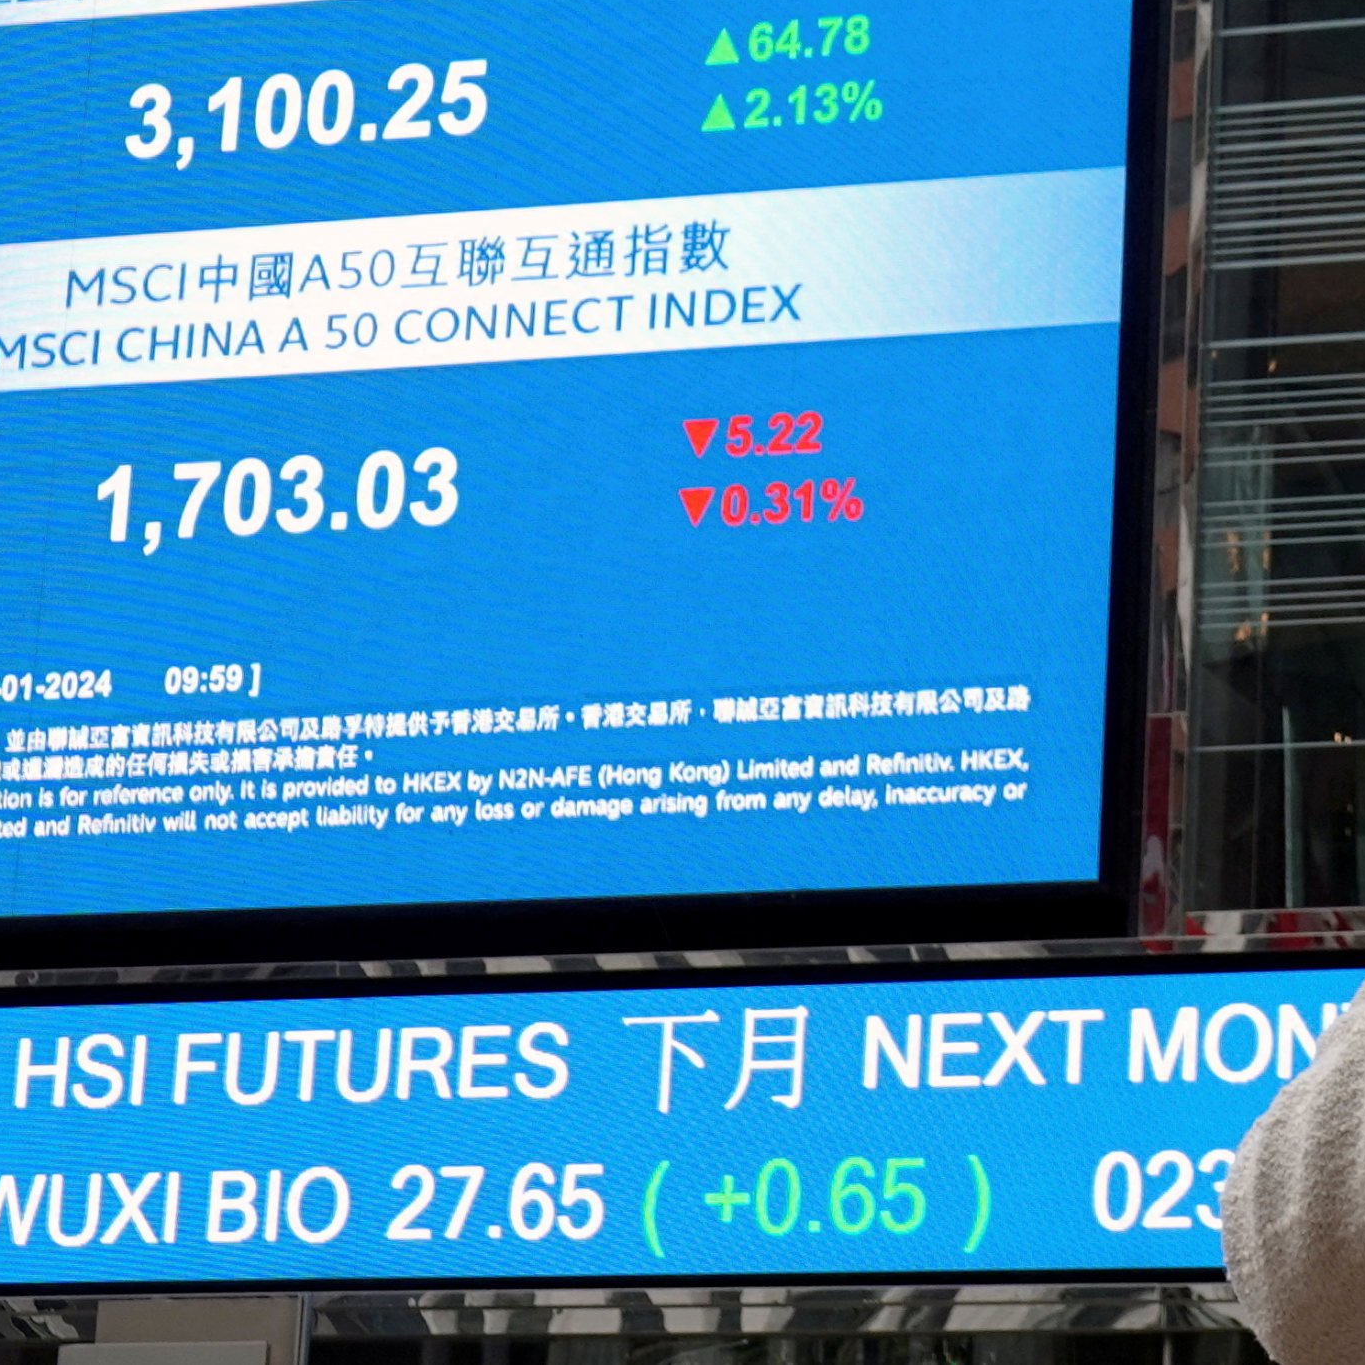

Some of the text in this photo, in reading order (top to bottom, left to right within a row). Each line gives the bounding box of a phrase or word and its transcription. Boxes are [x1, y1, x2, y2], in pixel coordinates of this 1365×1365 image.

[746, 14, 872, 63] 64.78
[124, 59, 488, 171] 3,100.25
[742, 81, 884, 129] 2.13%
[65, 218, 732, 310] MSCI中國A50互聯互通指數
[115, 319, 266, 364] CHINA
[277, 316, 310, 353] A
[324, 311, 379, 350] 50
[393, 294, 636, 346] CONNECT
[648, 282, 804, 331] INDEX
[725, 411, 825, 457] 5.22
[96, 446, 460, 557] 1,703.03
[719, 478, 864, 528] 0.31%
[33, 815, 71, 837] and
[77, 813, 157, 835] Refinitiv
[162, 810, 197, 832] will
[204, 810, 238, 831] not
[243, 808, 309, 833] accept
[315, 804, 389, 830] liability
[395, 802, 425, 824] for
[430, 804, 469, 827] any
[474, 799, 515, 821] loss
[520, 801, 545, 820] or
[550, 796, 634, 821] damage
[639, 793, 709, 818] arising
[715, 789, 767, 812] from
[772, 791, 812, 814] any
[818, 785, 879, 812] delay,
[885, 784, 997, 807] inaccuracy
[1002, 782, 1028, 801] or
[38, 787, 54, 808] is
[59, 785, 88, 807] for
[93, 782, 184, 806] reference
[189, 780, 235, 807] only.
[240, 780, 256, 800] It
[260, 779, 277, 799] is
[283, 775, 370, 803] provided
[374, 774, 398, 796] to
[402, 771, 462, 794] HKEX
[467, 770, 493, 796] by
[498, 765, 592, 789] N2N-AFE
[597, 764, 663, 790] (Hong
[669, 759, 731, 787] Kong)
[736, 755, 815, 781] Limited
[819, 754, 860, 778] and
[866, 751, 955, 776] Refinitiv.
[960, 747, 1029, 772] HKEX,
[14, 1032, 148, 1110] HSI
[172, 1021, 570, 1106] FUTURES
[622, 1005, 811, 1115] 下月
[862, 1008, 1106, 1090] NEXT
[1128, 1001, 1352, 1084] MON
[206, 1165, 351, 1245] BIO
[385, 1161, 606, 1242] 27.65
